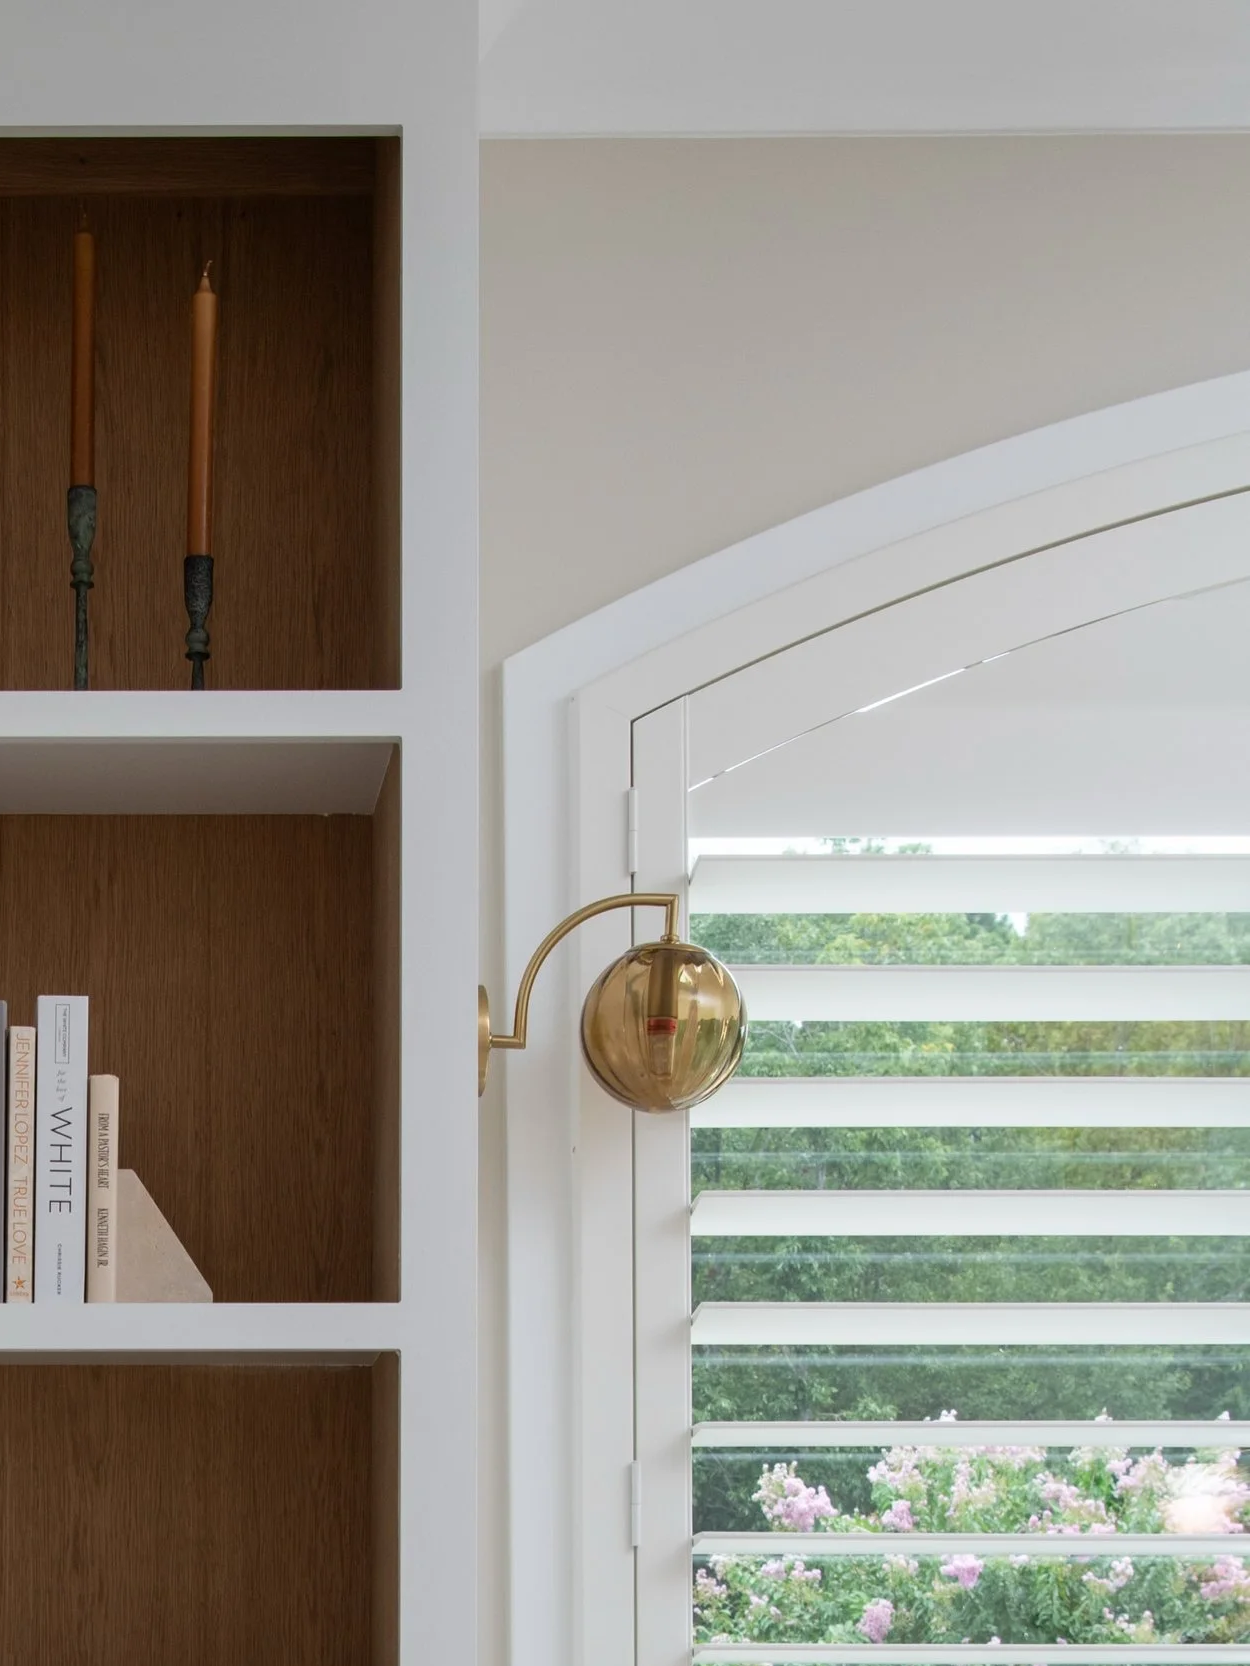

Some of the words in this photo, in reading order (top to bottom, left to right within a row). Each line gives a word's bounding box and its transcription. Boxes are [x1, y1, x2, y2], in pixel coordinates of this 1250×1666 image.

[15, 1033, 30, 1109] JENNIFER
[13, 1113, 29, 1164] LOPEZ
[98, 1113, 110, 1131] FROM
[49, 1107, 72, 1213] WHITE
[98, 1138, 110, 1168] PASTOR'S
[98, 1168, 109, 1189] HEART
[13, 1176, 28, 1217] TRUE
[97, 1208, 109, 1237] KENNETH
[12, 1222, 27, 1264] LOVE
[97, 1237, 109, 1257] HAGIN
